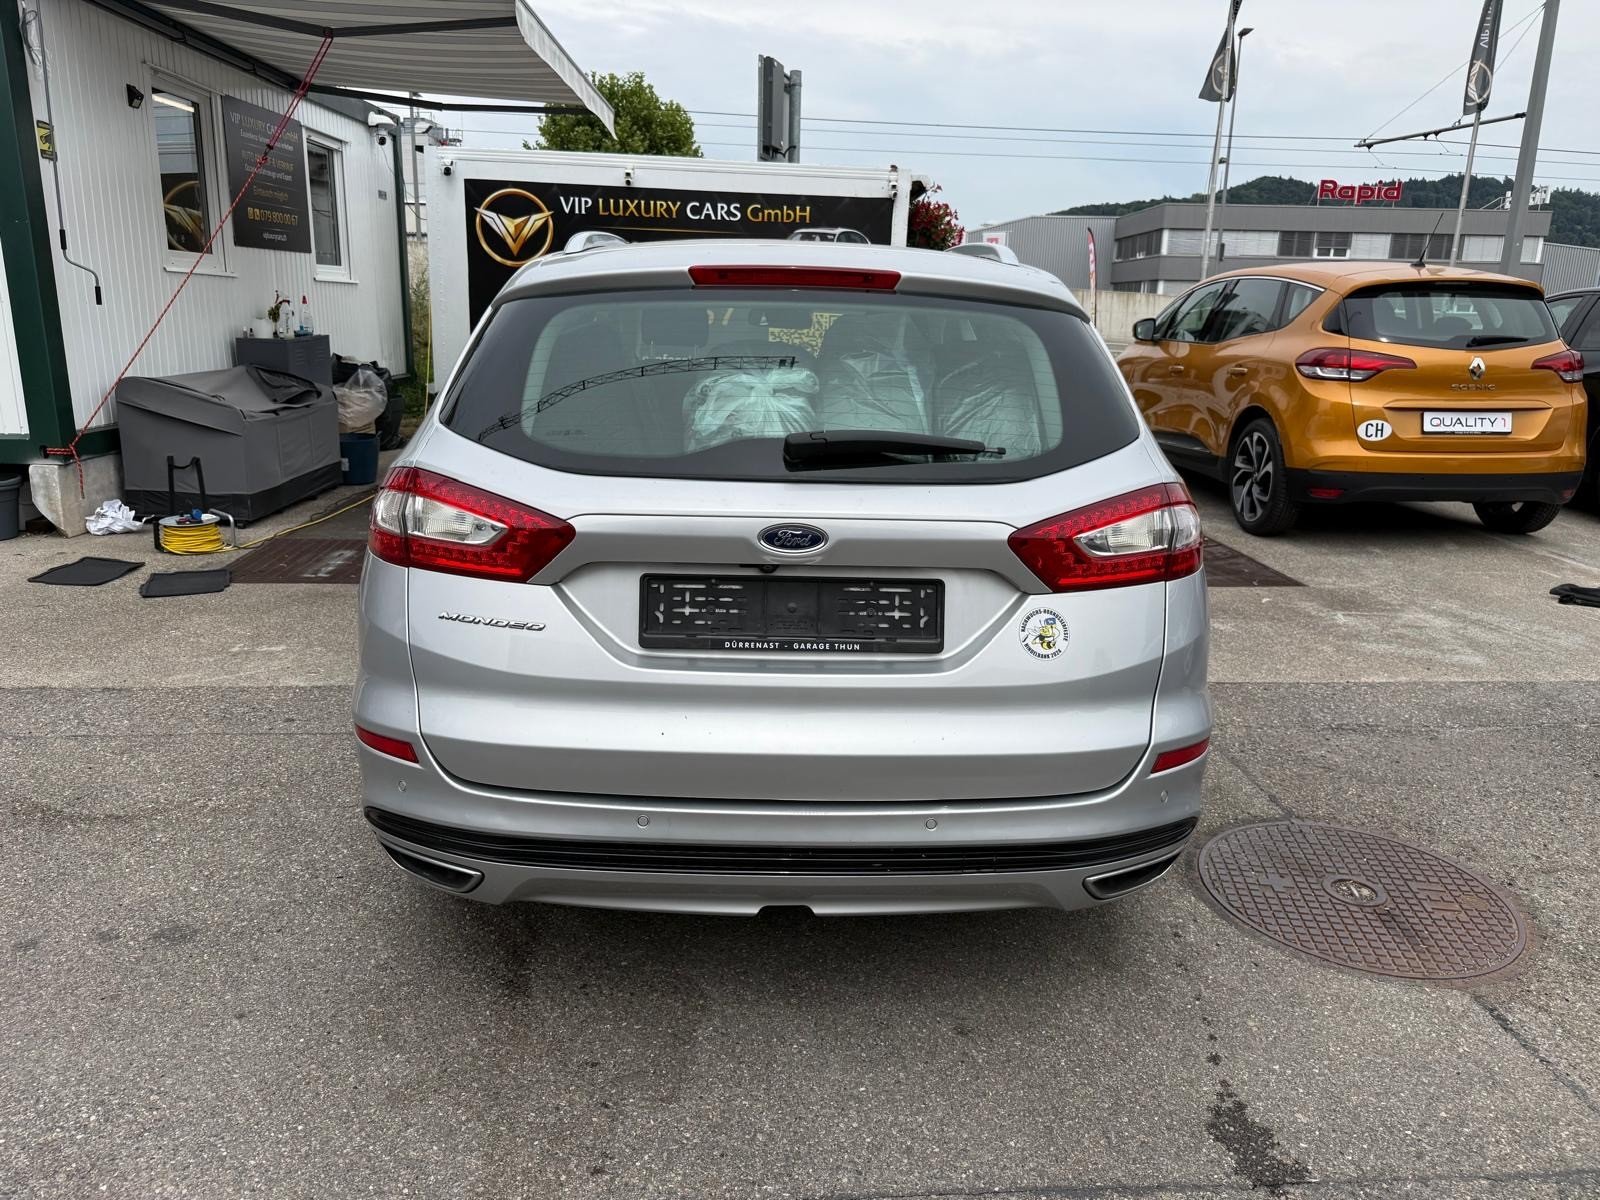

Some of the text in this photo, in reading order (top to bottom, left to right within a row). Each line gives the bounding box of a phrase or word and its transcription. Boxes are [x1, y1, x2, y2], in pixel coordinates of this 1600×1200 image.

[1317, 179, 1403, 204] Rapid
[559, 196, 811, 223] VIP LUXURY CARS GmbH
[1364, 422, 1384, 438] CH
[1429, 416, 1507, 428] QUALITY 1
[773, 529, 813, 546] Ford
[438, 611, 546, 631] MONDEO
[724, 640, 780, 649] DÜRRENAST
[793, 642, 830, 650] GARAGE
